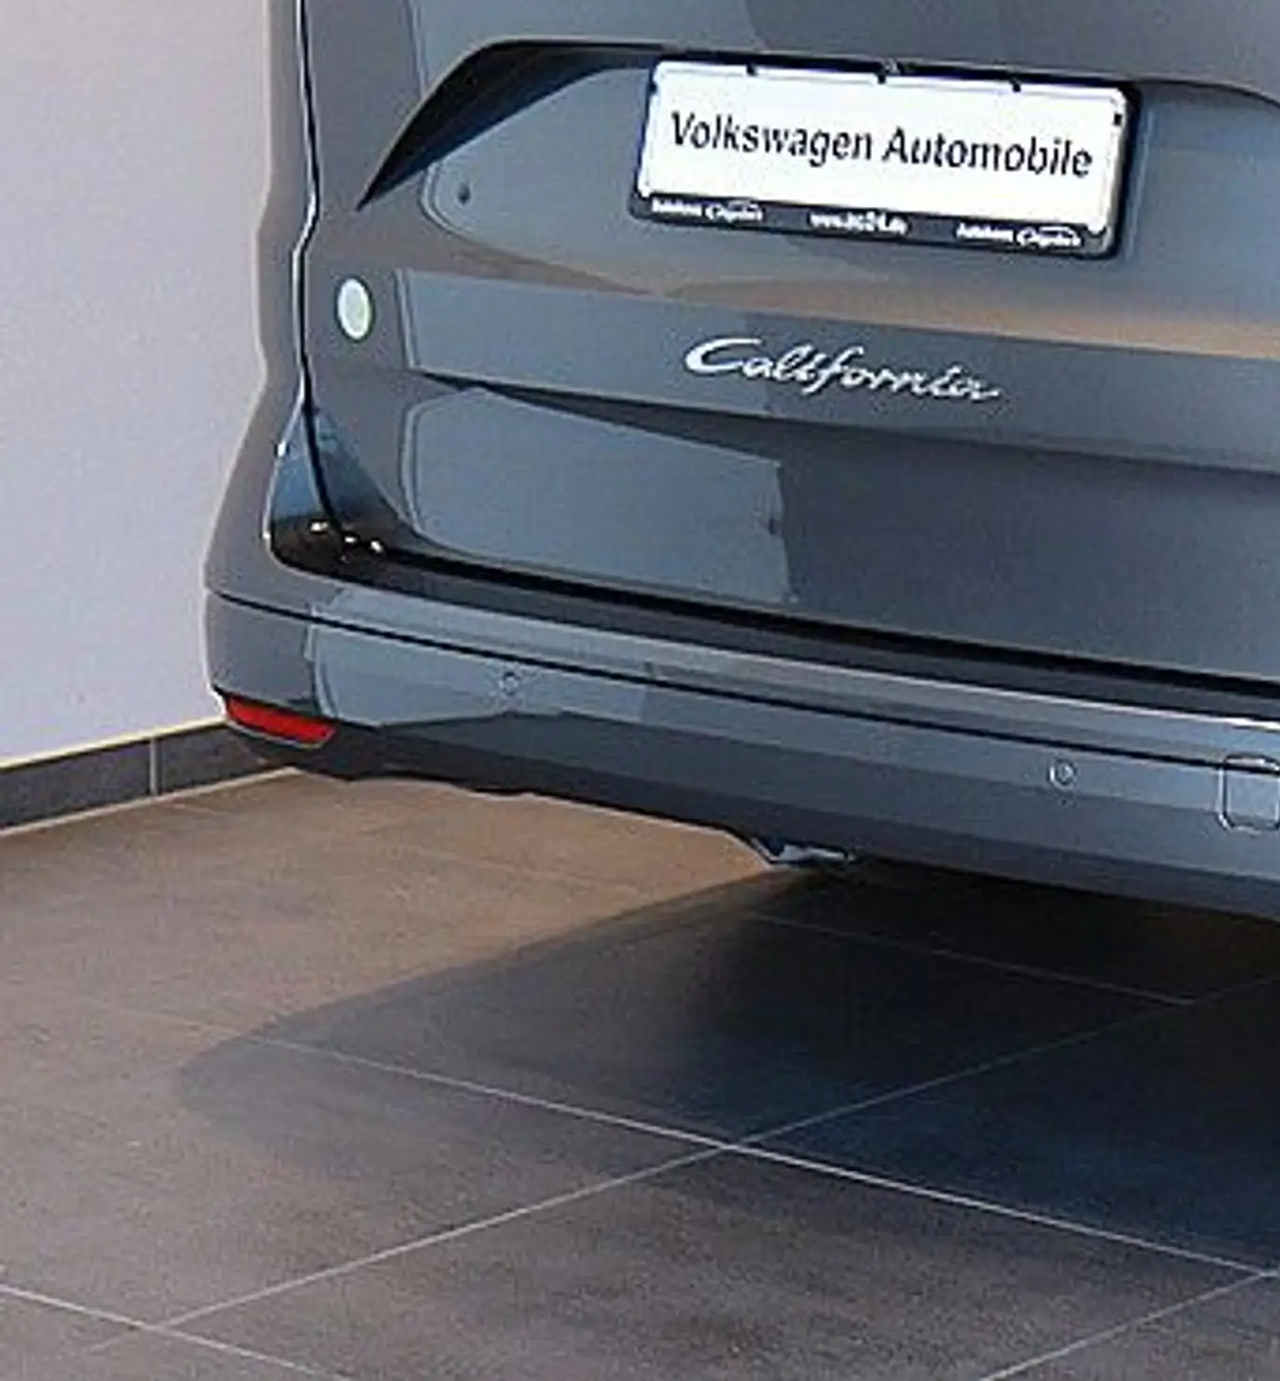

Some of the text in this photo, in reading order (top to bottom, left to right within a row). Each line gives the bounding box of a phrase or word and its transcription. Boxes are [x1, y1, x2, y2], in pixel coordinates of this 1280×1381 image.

[671, 110, 1093, 178] Volkswagen Automobile
[685, 337, 1001, 400] California
